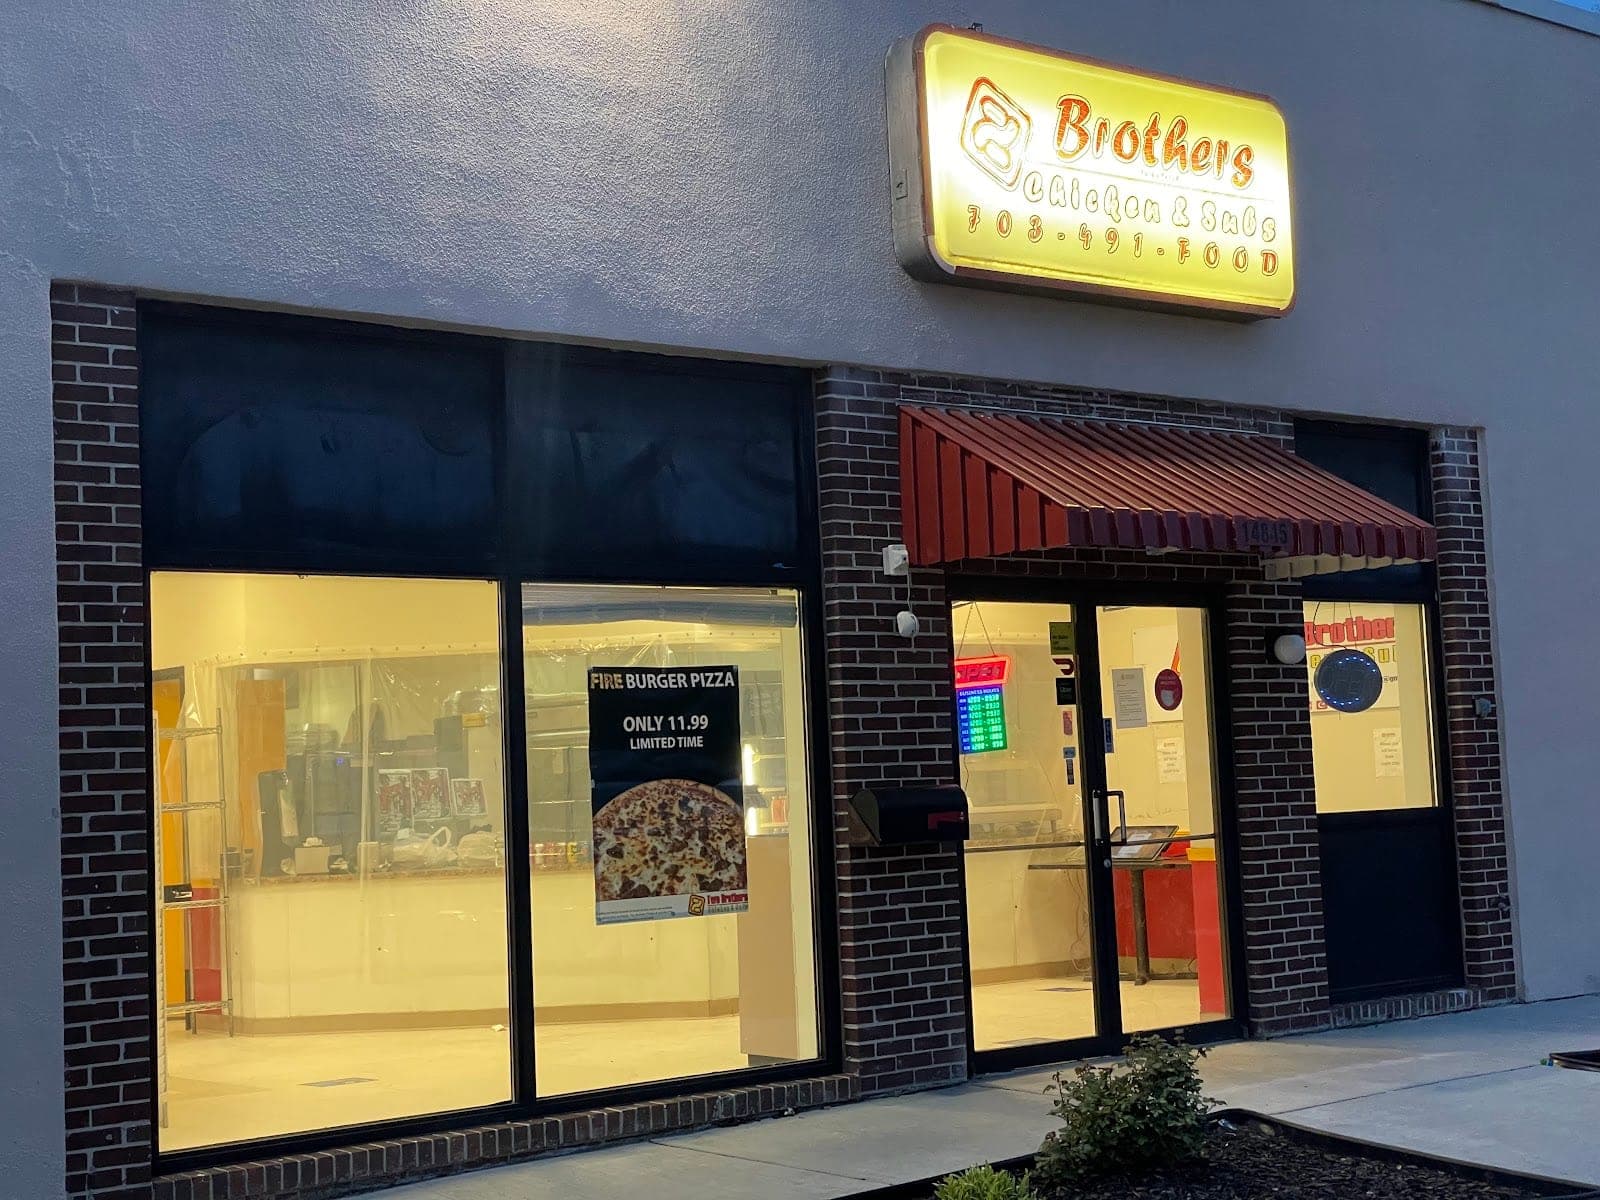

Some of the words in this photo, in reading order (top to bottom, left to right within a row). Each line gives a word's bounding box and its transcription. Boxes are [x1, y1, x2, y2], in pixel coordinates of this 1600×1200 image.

[1055, 94, 1254, 189] Brothers
[1023, 170, 1161, 224] Chicken
[1171, 196, 1190, 228] &
[1201, 200, 1277, 243] Subs
[590, 673, 623, 690] FIRE
[626, 673, 688, 689] BURGER
[690, 672, 735, 688] PIZZA
[623, 716, 664, 732] ONLY
[668, 715, 709, 731] 11.99
[630, 737, 675, 750] LIMITED
[677, 736, 704, 748] TIME
